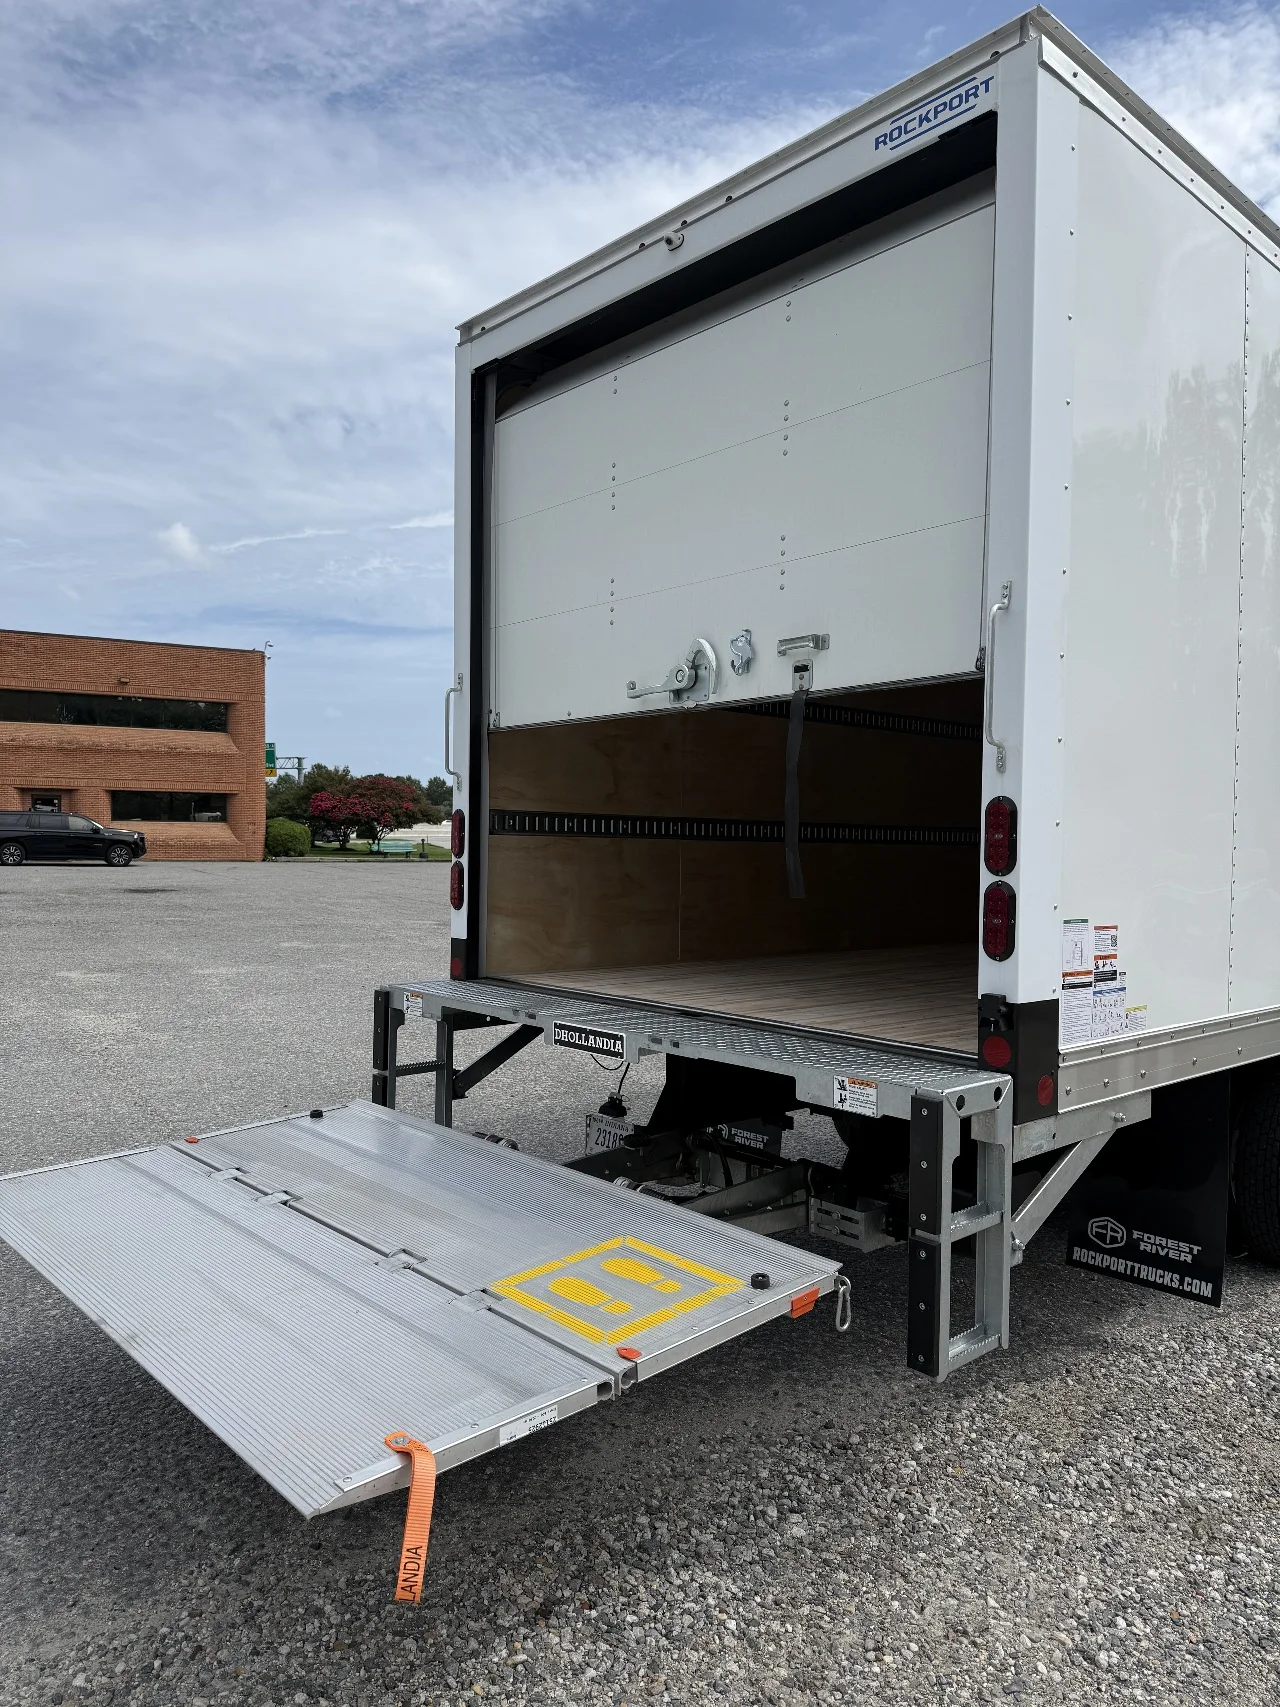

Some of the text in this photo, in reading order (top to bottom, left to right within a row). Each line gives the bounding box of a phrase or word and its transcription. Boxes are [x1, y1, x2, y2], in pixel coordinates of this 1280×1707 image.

[874, 75, 995, 151] ROCKPORT
[554, 1028, 623, 1053] DHOLLANDIA
[731, 1127, 769, 1143] FOREST
[734, 1136, 764, 1150] RIVER
[1131, 1229, 1202, 1255] FOREST
[1139, 1241, 1193, 1264] RIVER
[1072, 1246, 1213, 1298] ROCKPORTTRUCKS.COM
[398, 1545, 423, 1602] LANDIA
